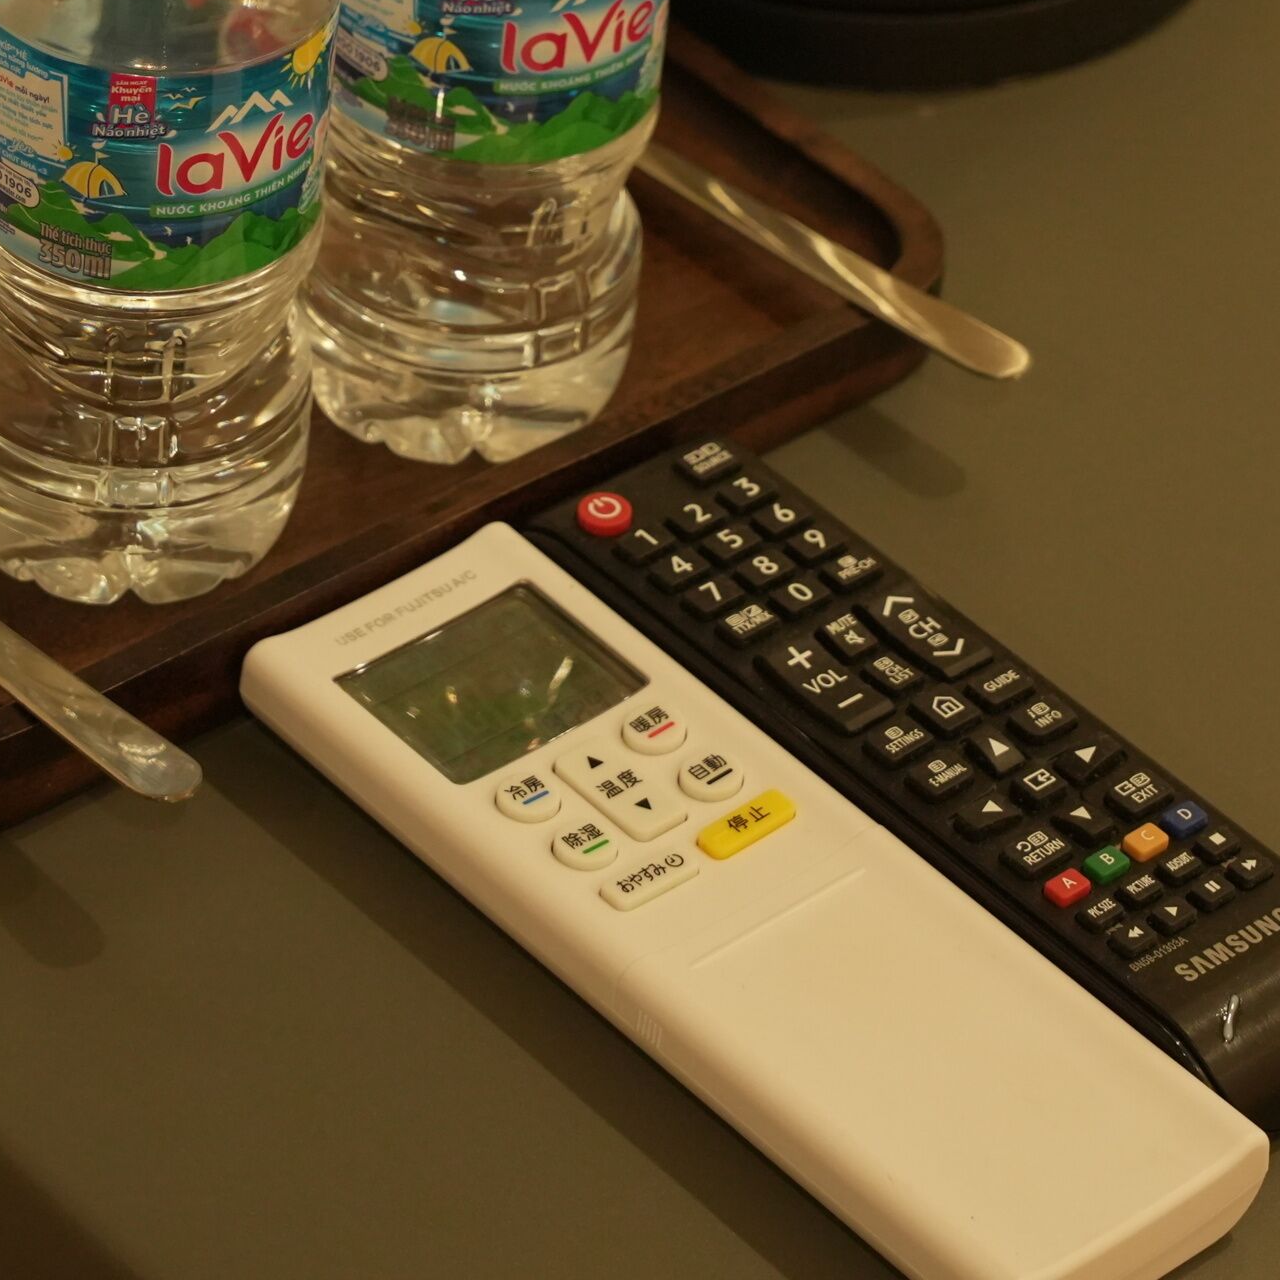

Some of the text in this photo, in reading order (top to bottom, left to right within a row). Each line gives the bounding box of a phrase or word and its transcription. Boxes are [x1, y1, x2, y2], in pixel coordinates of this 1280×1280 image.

[113, 105, 148, 124] Hè
[156, 111, 315, 196] laVie
[4, 172, 32, 199] 1906
[156, 202, 195, 216] NƯỚC
[199, 193, 251, 213] KHOÁNG
[255, 176, 286, 197] THIÊN
[39, 222, 113, 256] Thể tích thực
[39, 239, 111, 280] 350 ml
[732, 476, 761, 497] 3
[683, 503, 712, 523] 2
[773, 502, 796, 523] 6
[634, 528, 659, 546] 1
[716, 528, 744, 549] 5
[803, 528, 827, 549] 9
[670, 555, 694, 574] 4
[752, 555, 779, 575] 8
[698, 581, 722, 602] 7
[787, 582, 814, 601] 0
[334, 569, 478, 646] USE FOR FUJITSU A/C
[825, 613, 858, 635] MUTE
[908, 616, 942, 639] CH
[802, 668, 849, 695] VOL
[889, 667, 915, 685] LIST
[983, 669, 1021, 692] GUIDE
[628, 705, 671, 734] 暖房
[1034, 710, 1062, 728] INFO
[885, 728, 925, 754] SETTINGS
[687, 753, 728, 781] 自動
[928, 763, 968, 788] E-MANUAL
[504, 774, 546, 801] 冷房
[595, 768, 644, 800] 温度
[1131, 784, 1159, 804] EXIT
[726, 804, 771, 833] 停止
[1176, 808, 1193, 821] D
[561, 823, 605, 850] 除湿
[1140, 829, 1155, 841] C
[1023, 838, 1066, 866] RETURN
[1099, 852, 1115, 866] B
[616, 862, 668, 894] おやすみ
[1060, 876, 1078, 889] A
[1126, 874, 1156, 895] PICTURE
[1087, 897, 1117, 919] PIC SIZE
